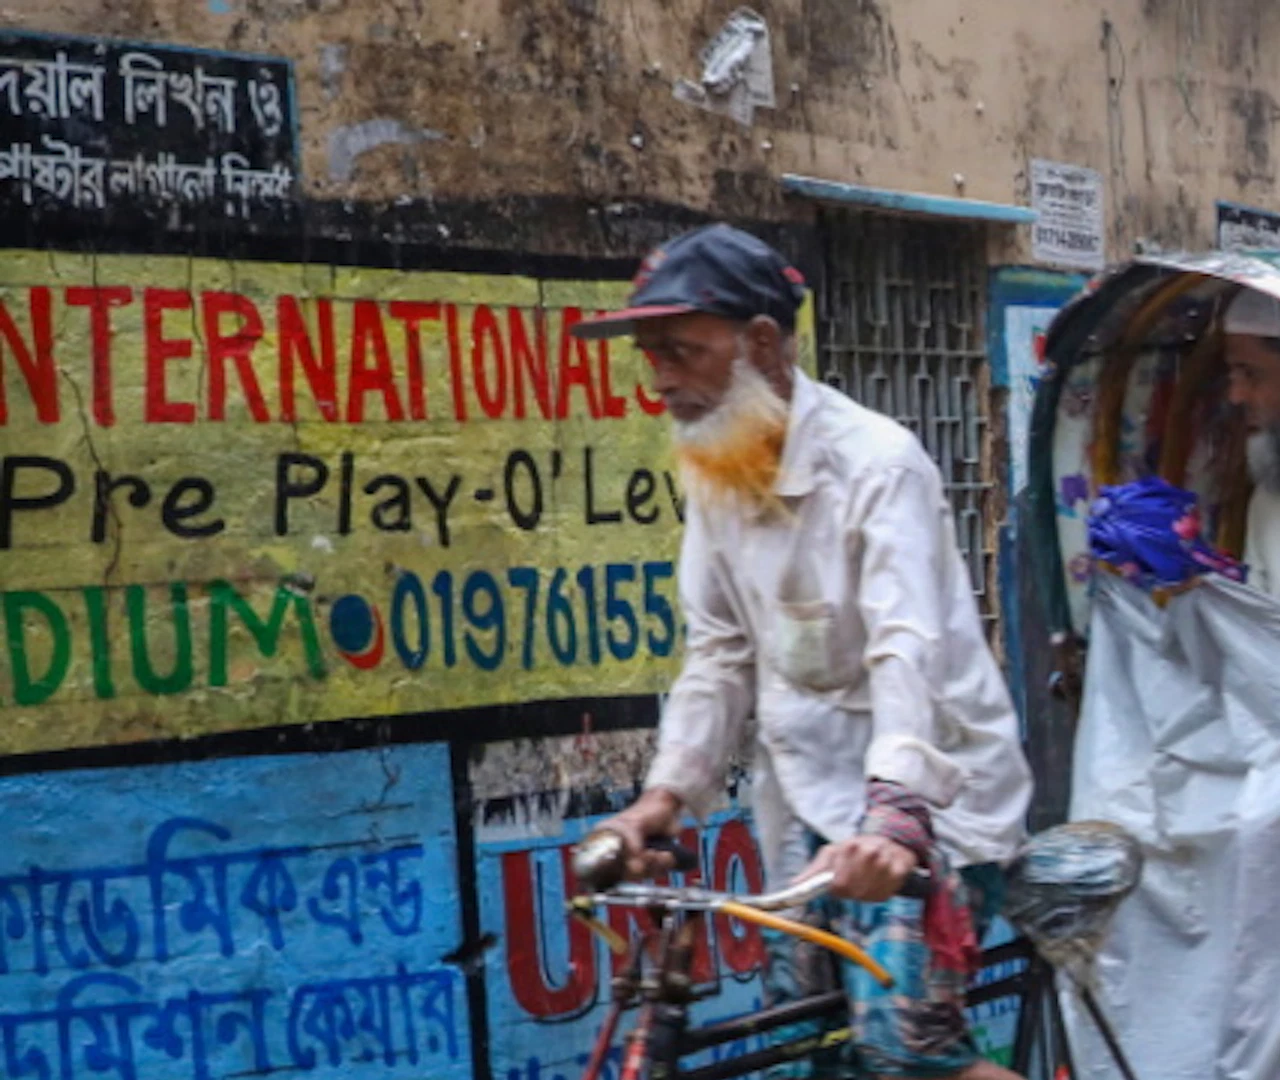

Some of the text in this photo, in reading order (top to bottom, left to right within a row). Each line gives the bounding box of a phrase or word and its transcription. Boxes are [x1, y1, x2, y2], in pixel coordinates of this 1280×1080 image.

[119, 53, 237, 133] লিখন
[0, 454, 225, 549] Pre
[3, 576, 327, 707] DIUM
[288, 962, 459, 1071] কেয়ার
